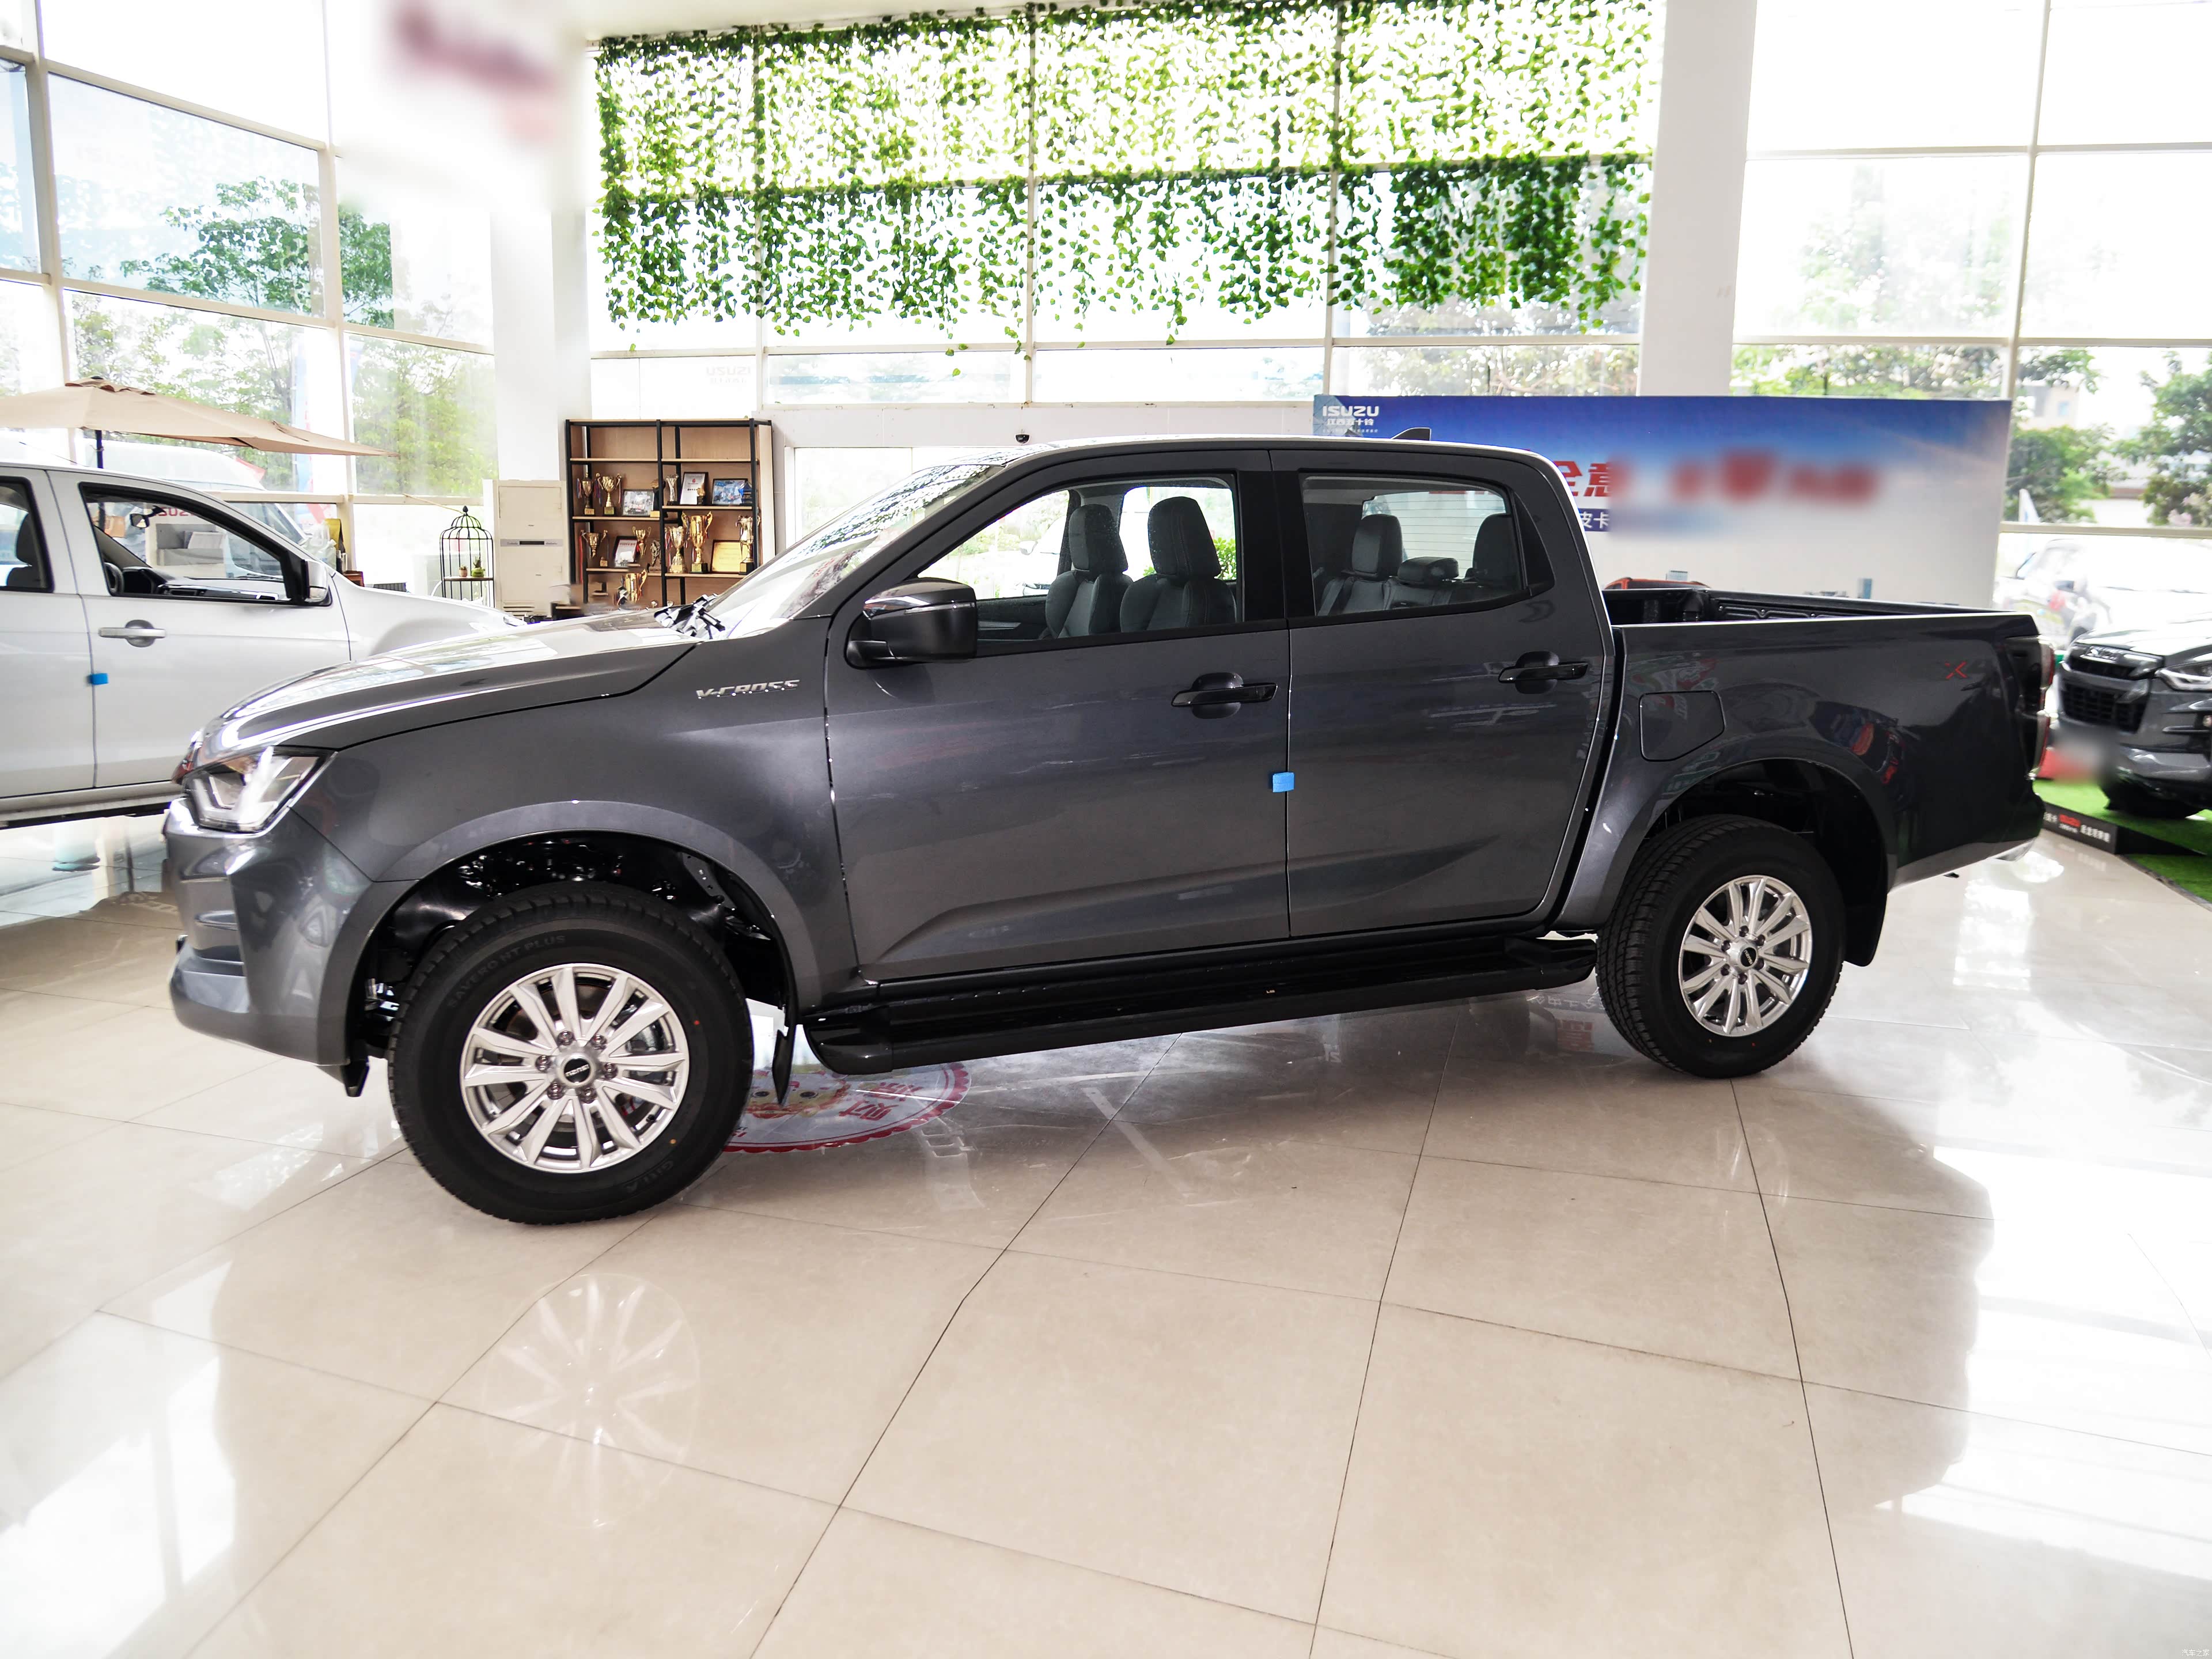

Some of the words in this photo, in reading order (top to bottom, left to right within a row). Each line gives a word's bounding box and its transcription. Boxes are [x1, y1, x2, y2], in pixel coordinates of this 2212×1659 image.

[1322, 406, 1379, 416] ISUZU
[524, 935, 566, 950] PLUS
[565, 1064, 589, 1077] ISUZU
